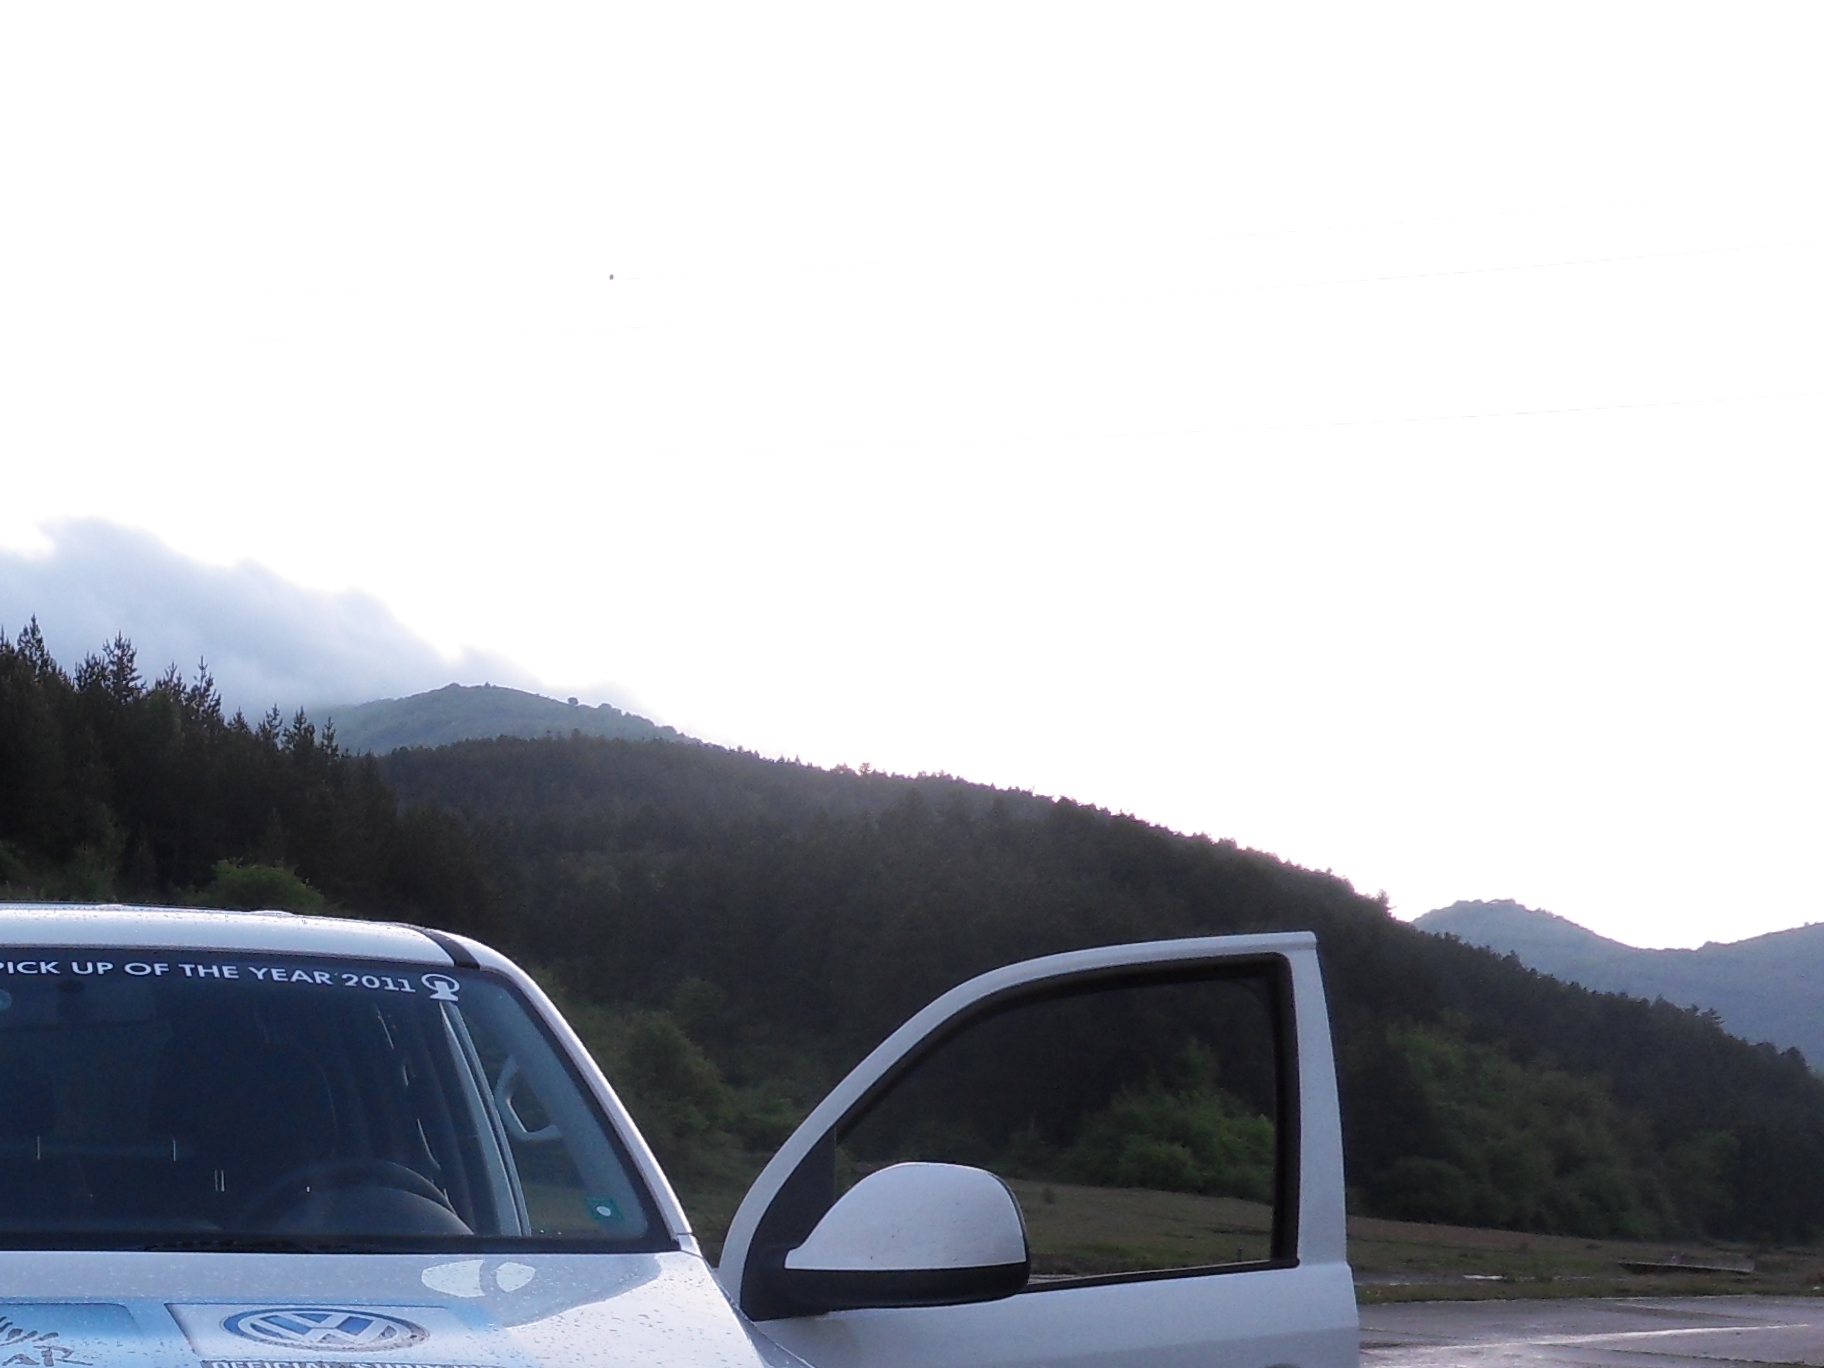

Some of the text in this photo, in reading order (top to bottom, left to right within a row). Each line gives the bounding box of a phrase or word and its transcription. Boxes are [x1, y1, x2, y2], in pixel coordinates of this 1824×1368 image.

[71, 960, 114, 976] UP
[124, 962, 170, 977] OF
[178, 963, 240, 980] THE
[248, 966, 334, 986] YEAR
[341, 973, 416, 993] 2011
